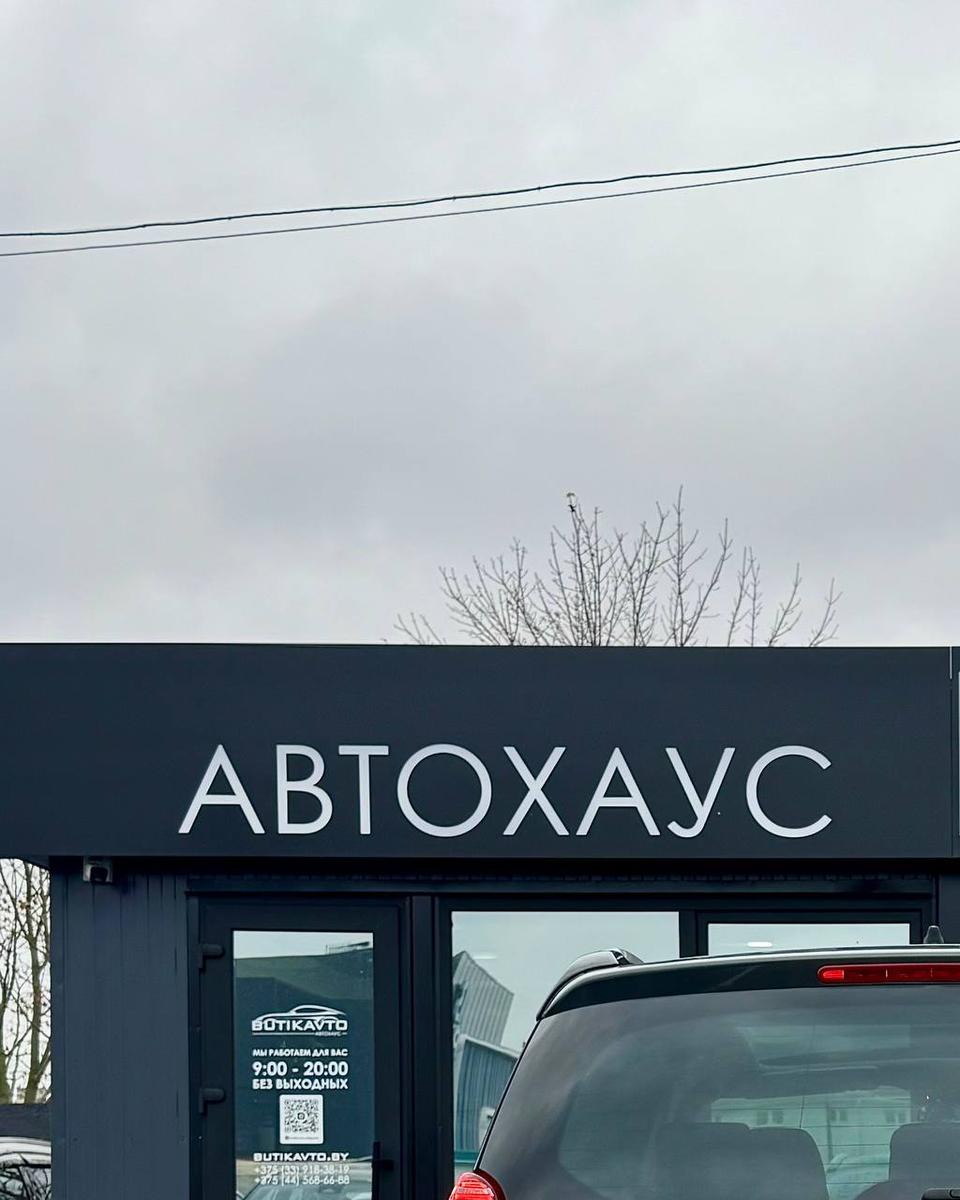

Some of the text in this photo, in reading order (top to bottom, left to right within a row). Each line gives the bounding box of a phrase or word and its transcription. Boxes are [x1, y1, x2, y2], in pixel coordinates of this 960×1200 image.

[177, 742, 833, 838] АВТОХАУС
[251, 1019, 348, 1031] BUTIKAVTO
[252, 1048, 348, 1057] МЫ РАБОТАЕМ ДЛЯ ВАС
[252, 1061, 288, 1076] 9:00
[303, 1061, 349, 1076] 20:00
[252, 1078, 349, 1090] БЕЗ ВЫХОДНЫХ
[253, 1152, 350, 1162] BUTIKAVTO.BY
[281, 1175, 300, 1187] (44)
[302, 1175, 350, 1185] 568-66-88
